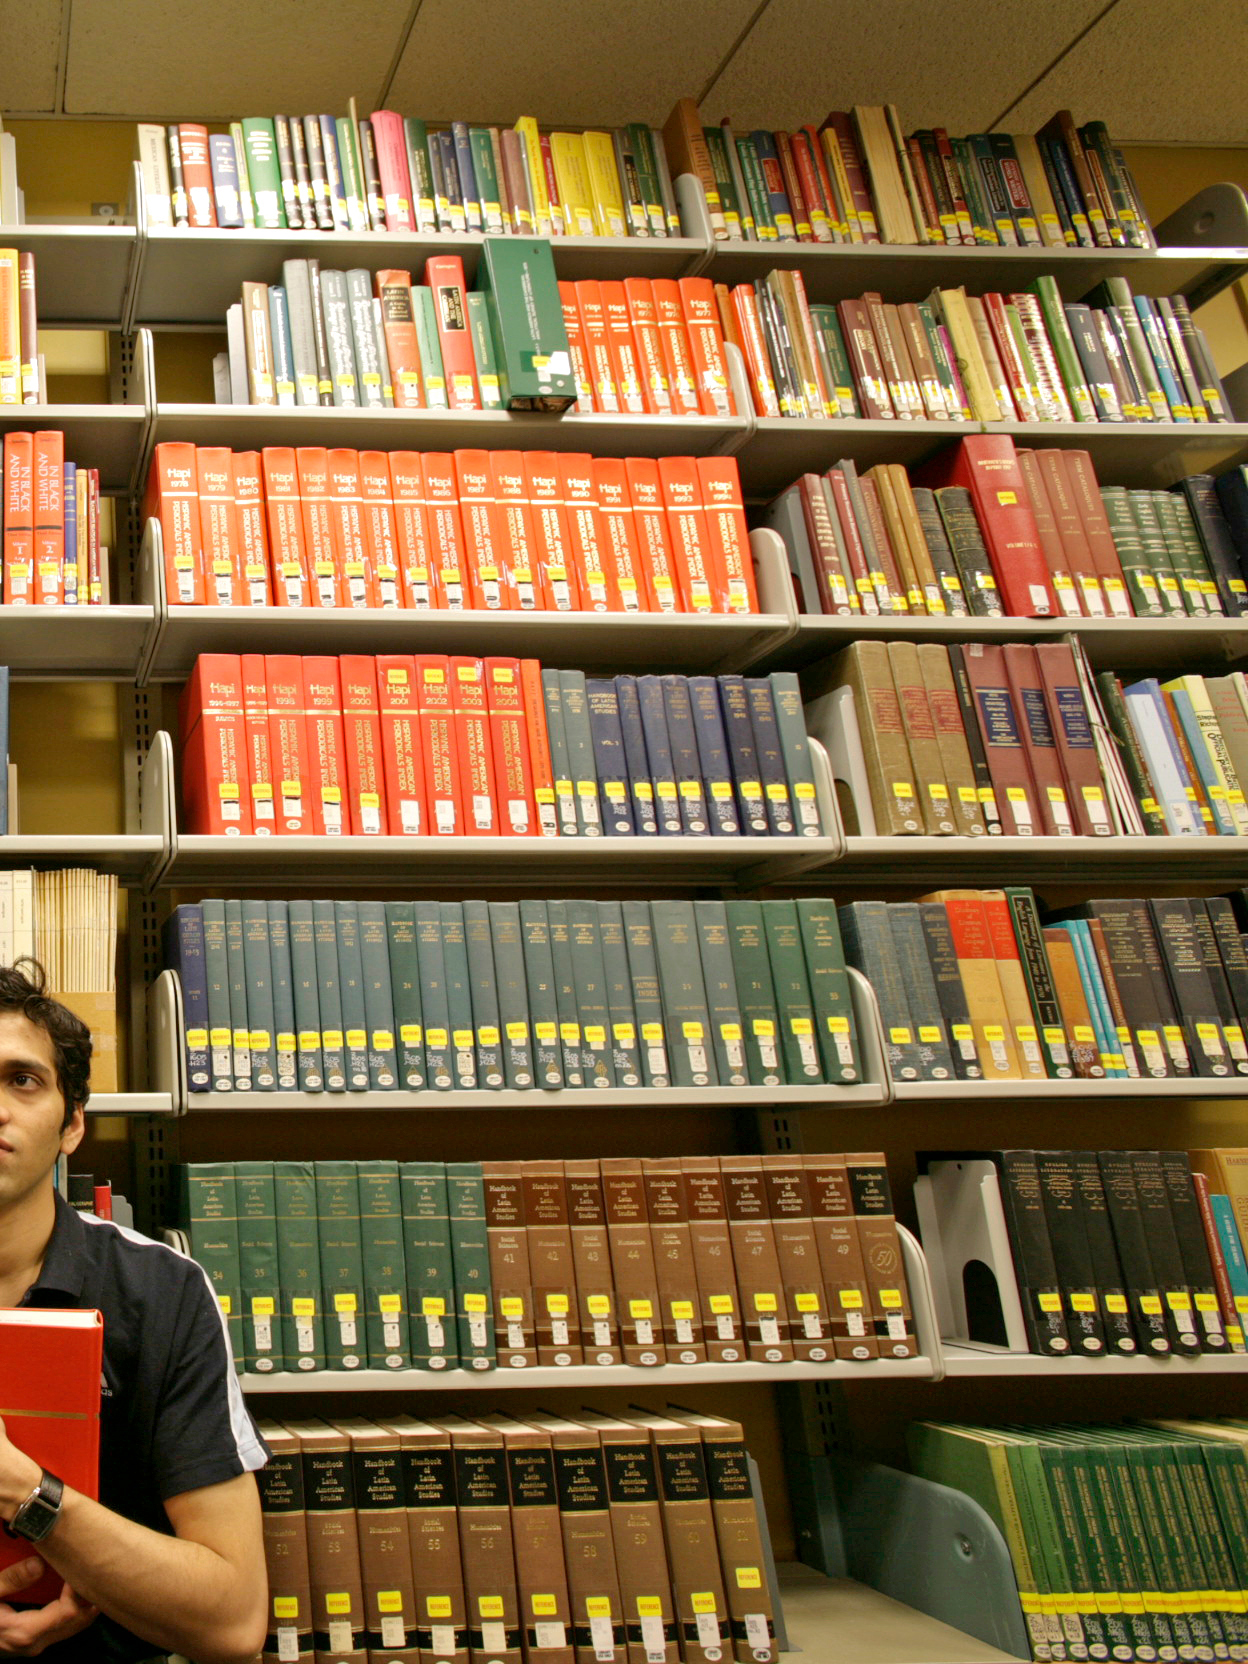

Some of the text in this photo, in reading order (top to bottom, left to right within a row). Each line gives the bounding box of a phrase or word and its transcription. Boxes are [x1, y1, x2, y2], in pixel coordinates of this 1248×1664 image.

[455, 306, 463, 327] AMERICA
[10, 454, 19, 512] AND WHITE
[21, 467, 30, 511] IN BLACK
[670, 482, 694, 495] Hapi
[679, 514, 697, 577] PERIODICALS INDEX
[687, 514, 706, 580] HISPANIC AMERICAN
[494, 685, 518, 698] Hapi
[501, 719, 514, 791] PERIODICALS INDEX
[509, 720, 523, 795] HISPANIC AMERICAN
[474, 1473, 489, 1481] Latin
[481, 1538, 494, 1549] 56
